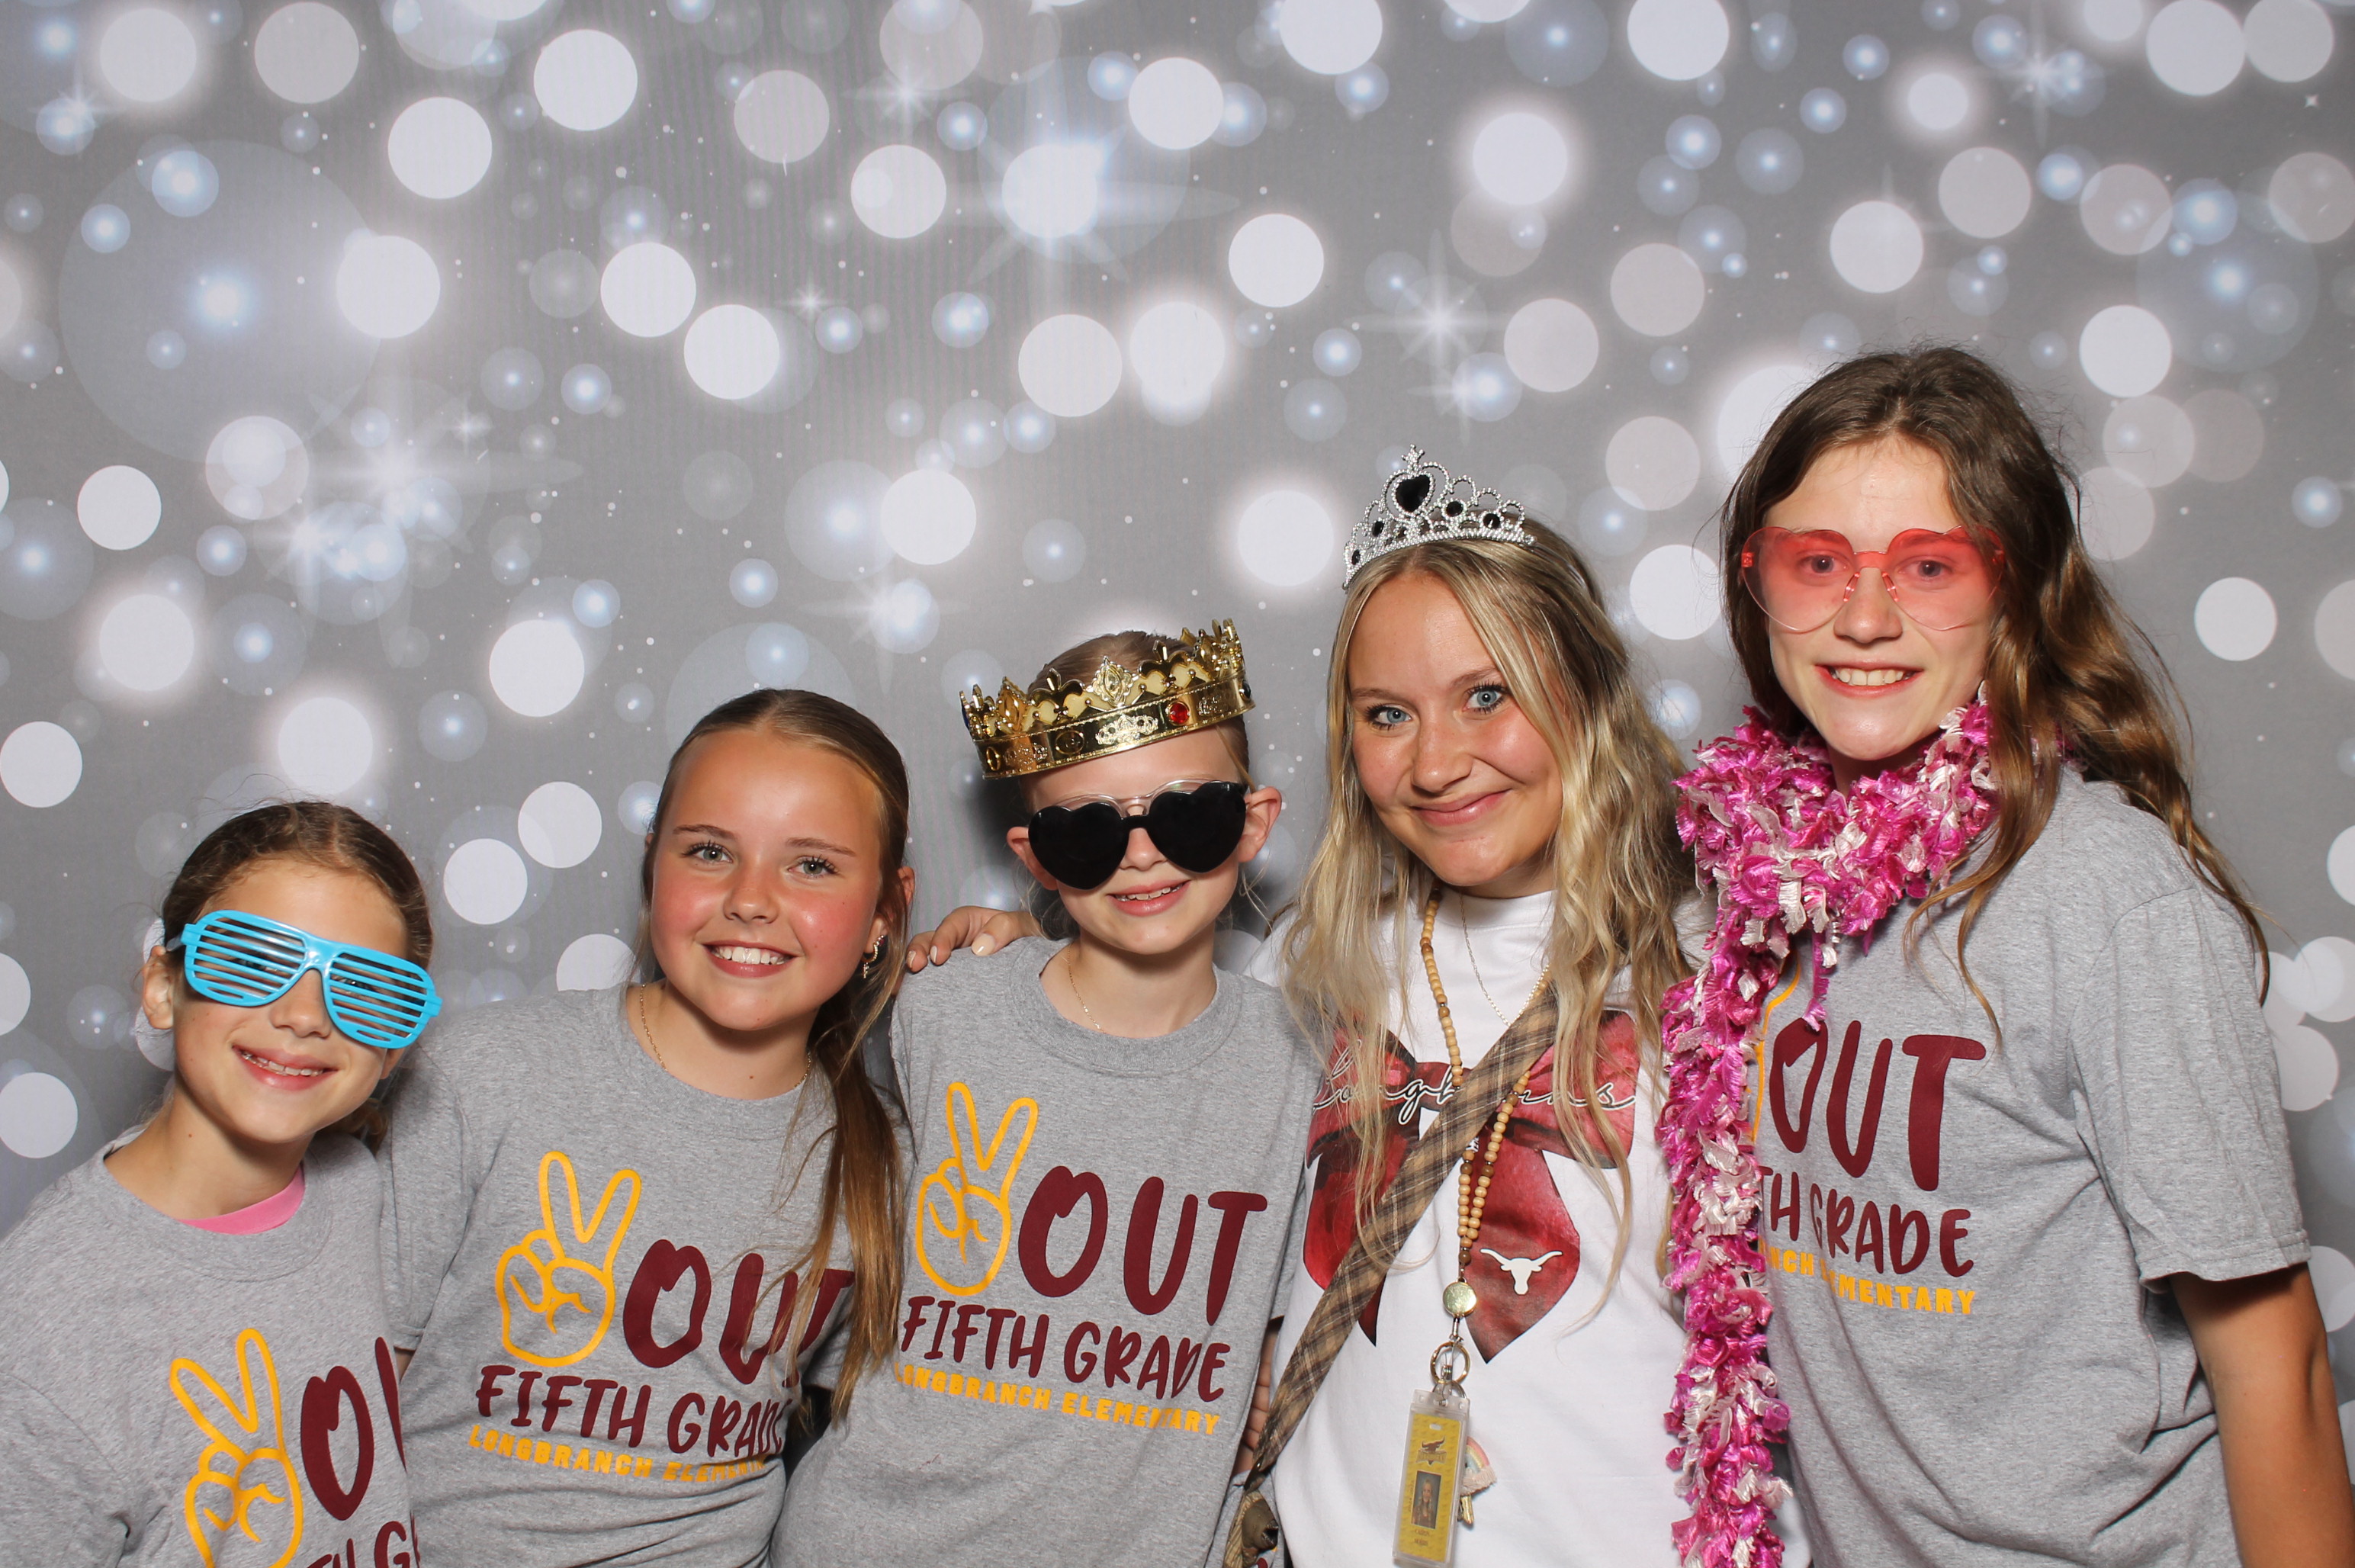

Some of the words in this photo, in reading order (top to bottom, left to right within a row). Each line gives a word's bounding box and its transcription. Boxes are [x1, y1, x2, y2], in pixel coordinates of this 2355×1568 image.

[1769, 1017, 1987, 1191] OUT
[1018, 1165, 1267, 1325] OUT
[1810, 1183, 1974, 1277] GRADE
[622, 1239, 856, 1388] OUT
[901, 1296, 1049, 1378] FIFTH
[1063, 1321, 1230, 1403] GRADE
[476, 1365, 652, 1448] FIFTH
[667, 1392, 793, 1458] GRADE
[894, 1361, 1051, 1411] LONGBRANCH
[1062, 1392, 1220, 1435] ELEMENTARY
[468, 1425, 653, 1479] LONGBRANCH
